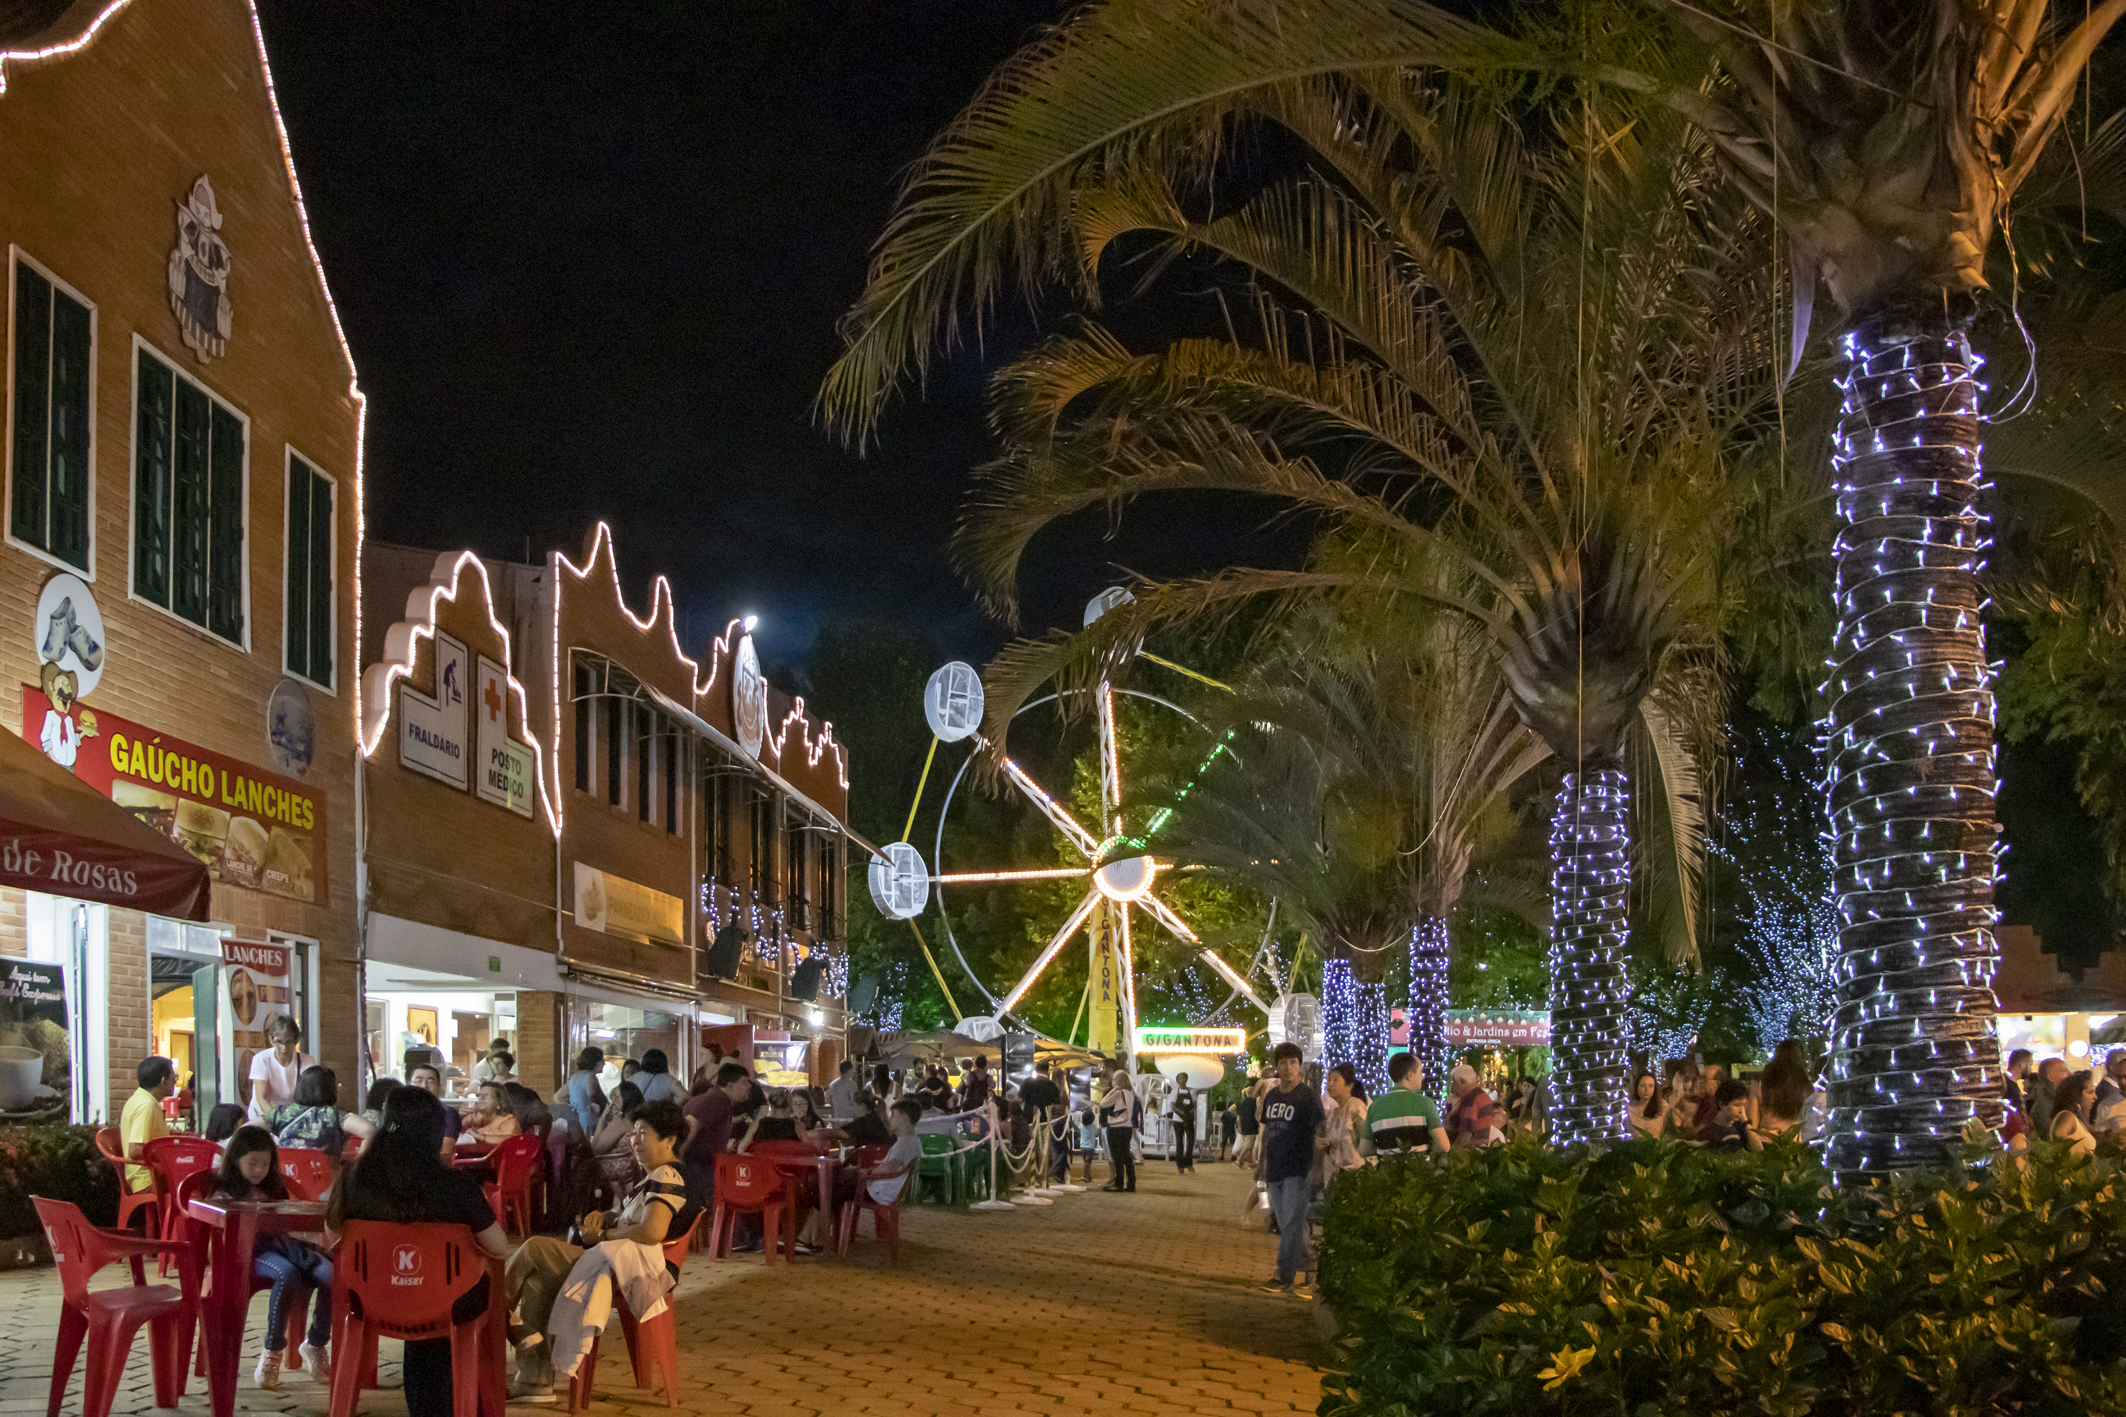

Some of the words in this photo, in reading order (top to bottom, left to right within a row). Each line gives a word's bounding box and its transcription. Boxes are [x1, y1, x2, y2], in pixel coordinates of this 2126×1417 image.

[408, 722, 460, 760] FRALDÁRIO
[491, 747, 522, 776] POSTO
[110, 733, 215, 799] GAÚCHO
[221, 769, 314, 830] LANCHES
[488, 769, 524, 799] MÉDICO
[3, 838, 41, 875] de
[50, 849, 138, 896] Rosas
[266, 868, 290, 884] CREPE
[224, 944, 283, 967] LANCHES
[1101, 895, 1111, 1002] GIGANTONA
[1145, 1033, 1232, 1048] GIGANTONA
[1472, 1025, 1510, 1037] Jardins
[1512, 1029, 1527, 1038] em
[739, 1166, 748, 1178] K
[398, 1249, 417, 1271] K
[390, 1275, 425, 1287] Kaiser
